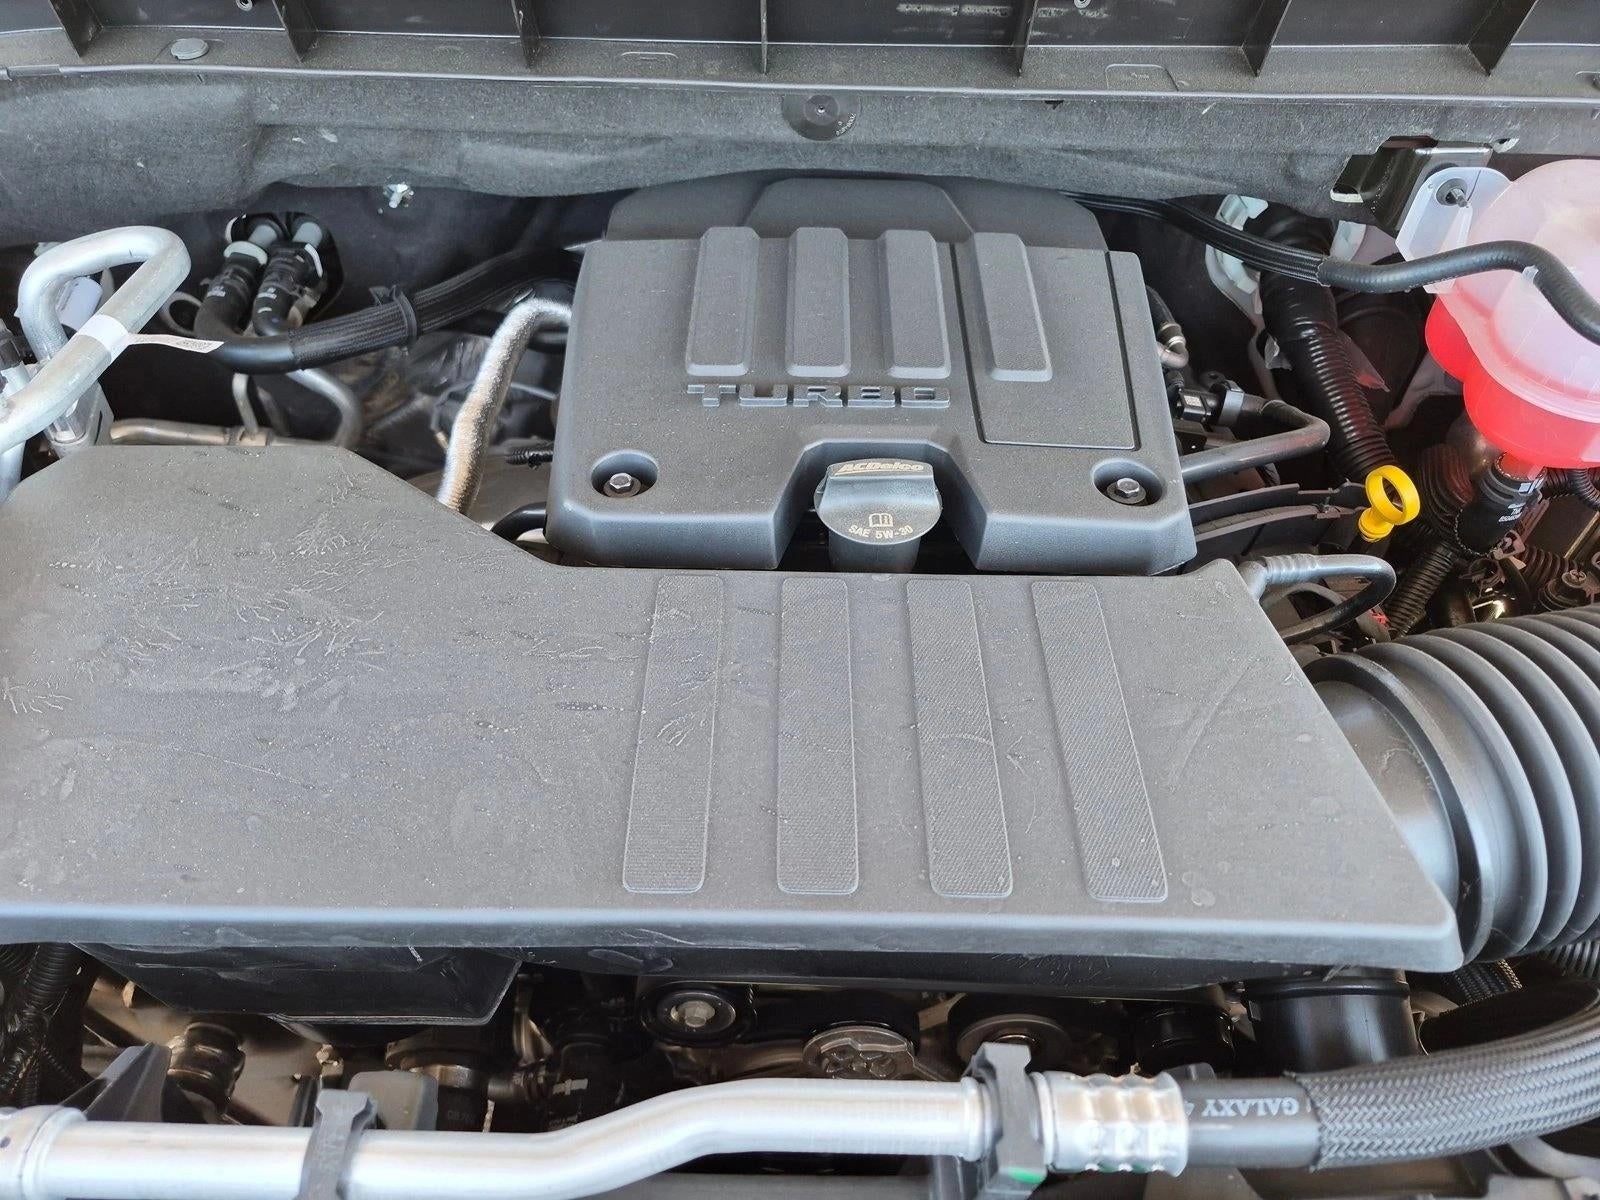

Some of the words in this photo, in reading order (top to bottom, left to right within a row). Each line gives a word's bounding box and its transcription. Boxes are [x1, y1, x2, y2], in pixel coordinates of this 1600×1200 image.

[687, 384, 950, 409] TURBO
[836, 462, 924, 474] ACDelco
[848, 524, 871, 538] SAE
[875, 524, 914, 539] 5W-30
[1201, 1096, 1300, 1117] GALAXY
